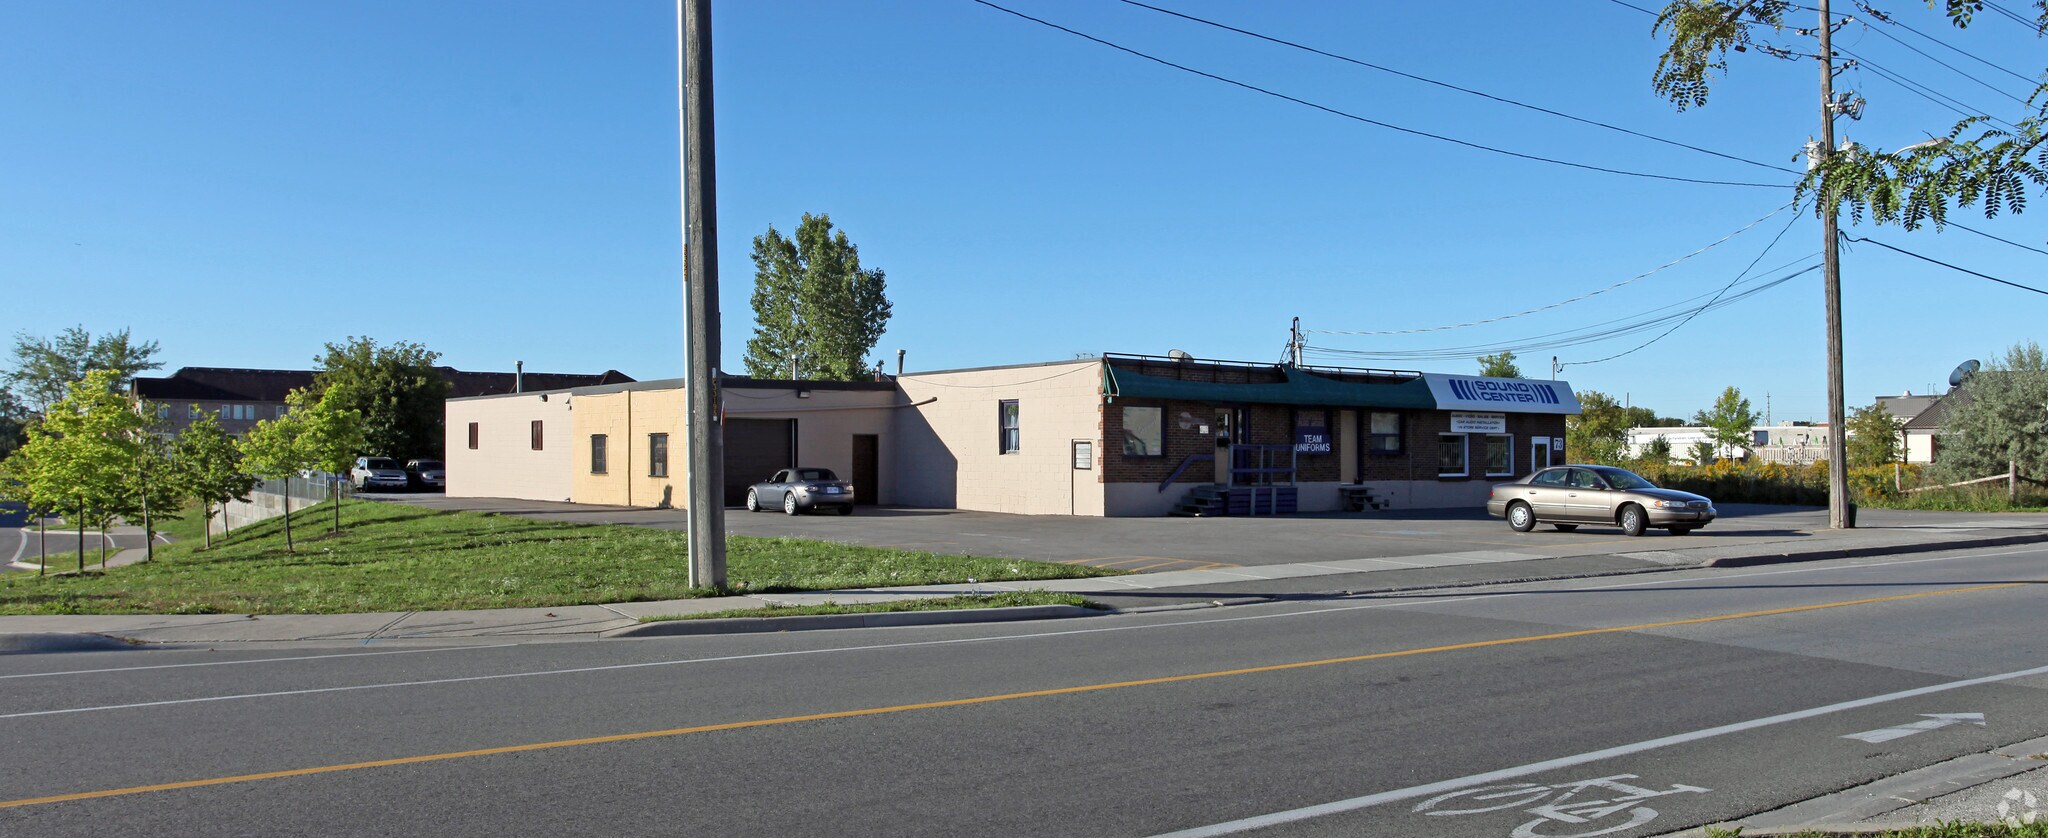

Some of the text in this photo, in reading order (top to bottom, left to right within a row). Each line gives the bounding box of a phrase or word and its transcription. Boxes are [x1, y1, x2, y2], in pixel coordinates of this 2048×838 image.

[1475, 380, 1530, 392] SOUND
[1480, 391, 1535, 403] CENTER
[1304, 434, 1323, 443] TEAM
[1295, 443, 1330, 452] UNIFORMS
[1555, 439, 1563, 449] 73
